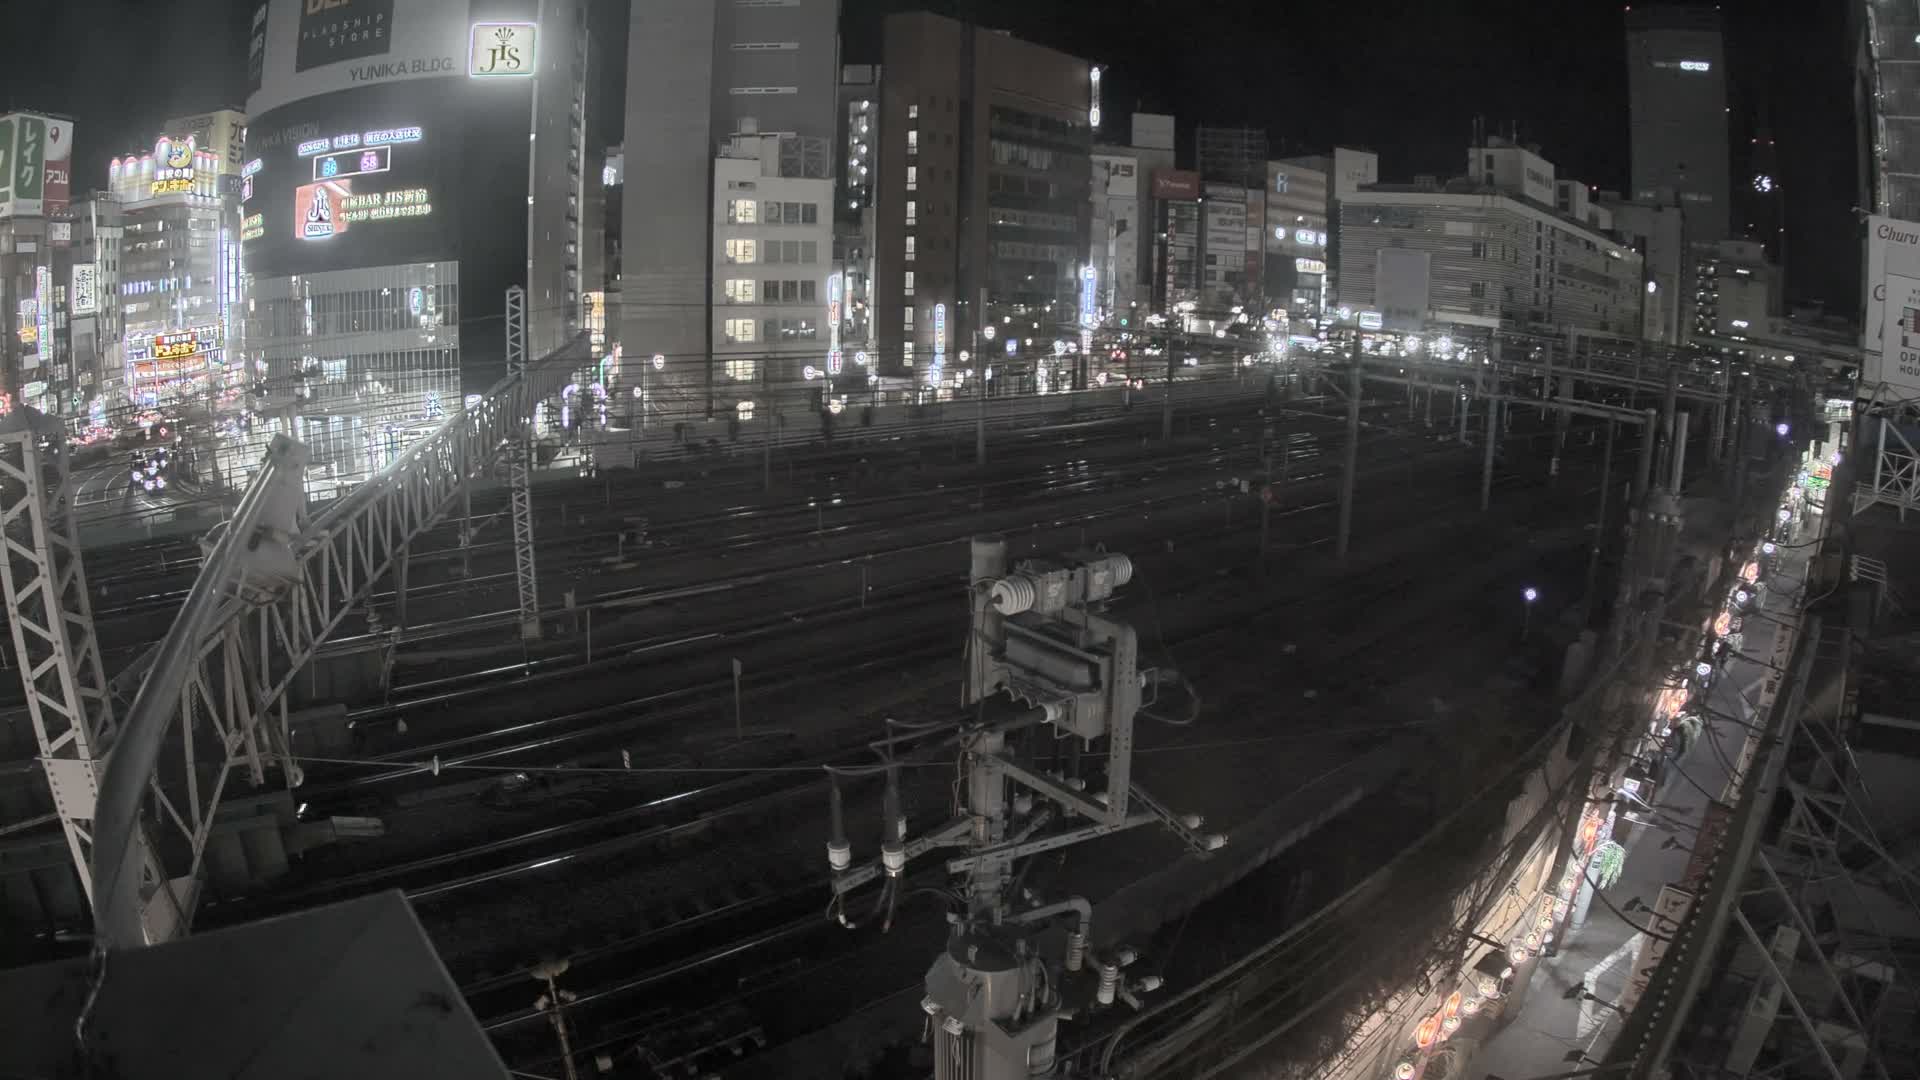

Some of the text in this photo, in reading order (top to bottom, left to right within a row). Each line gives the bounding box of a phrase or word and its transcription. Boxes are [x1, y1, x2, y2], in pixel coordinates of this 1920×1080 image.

[480, 40, 521, 73] JIS
[351, 62, 408, 81] YUNIKA
[21, 120, 37, 188] レイク
[362, 156, 377, 170] 58
[46, 168, 68, 185] アコム
[1878, 224, 1919, 245] Churu
[1900, 351, 1920, 363] OP
